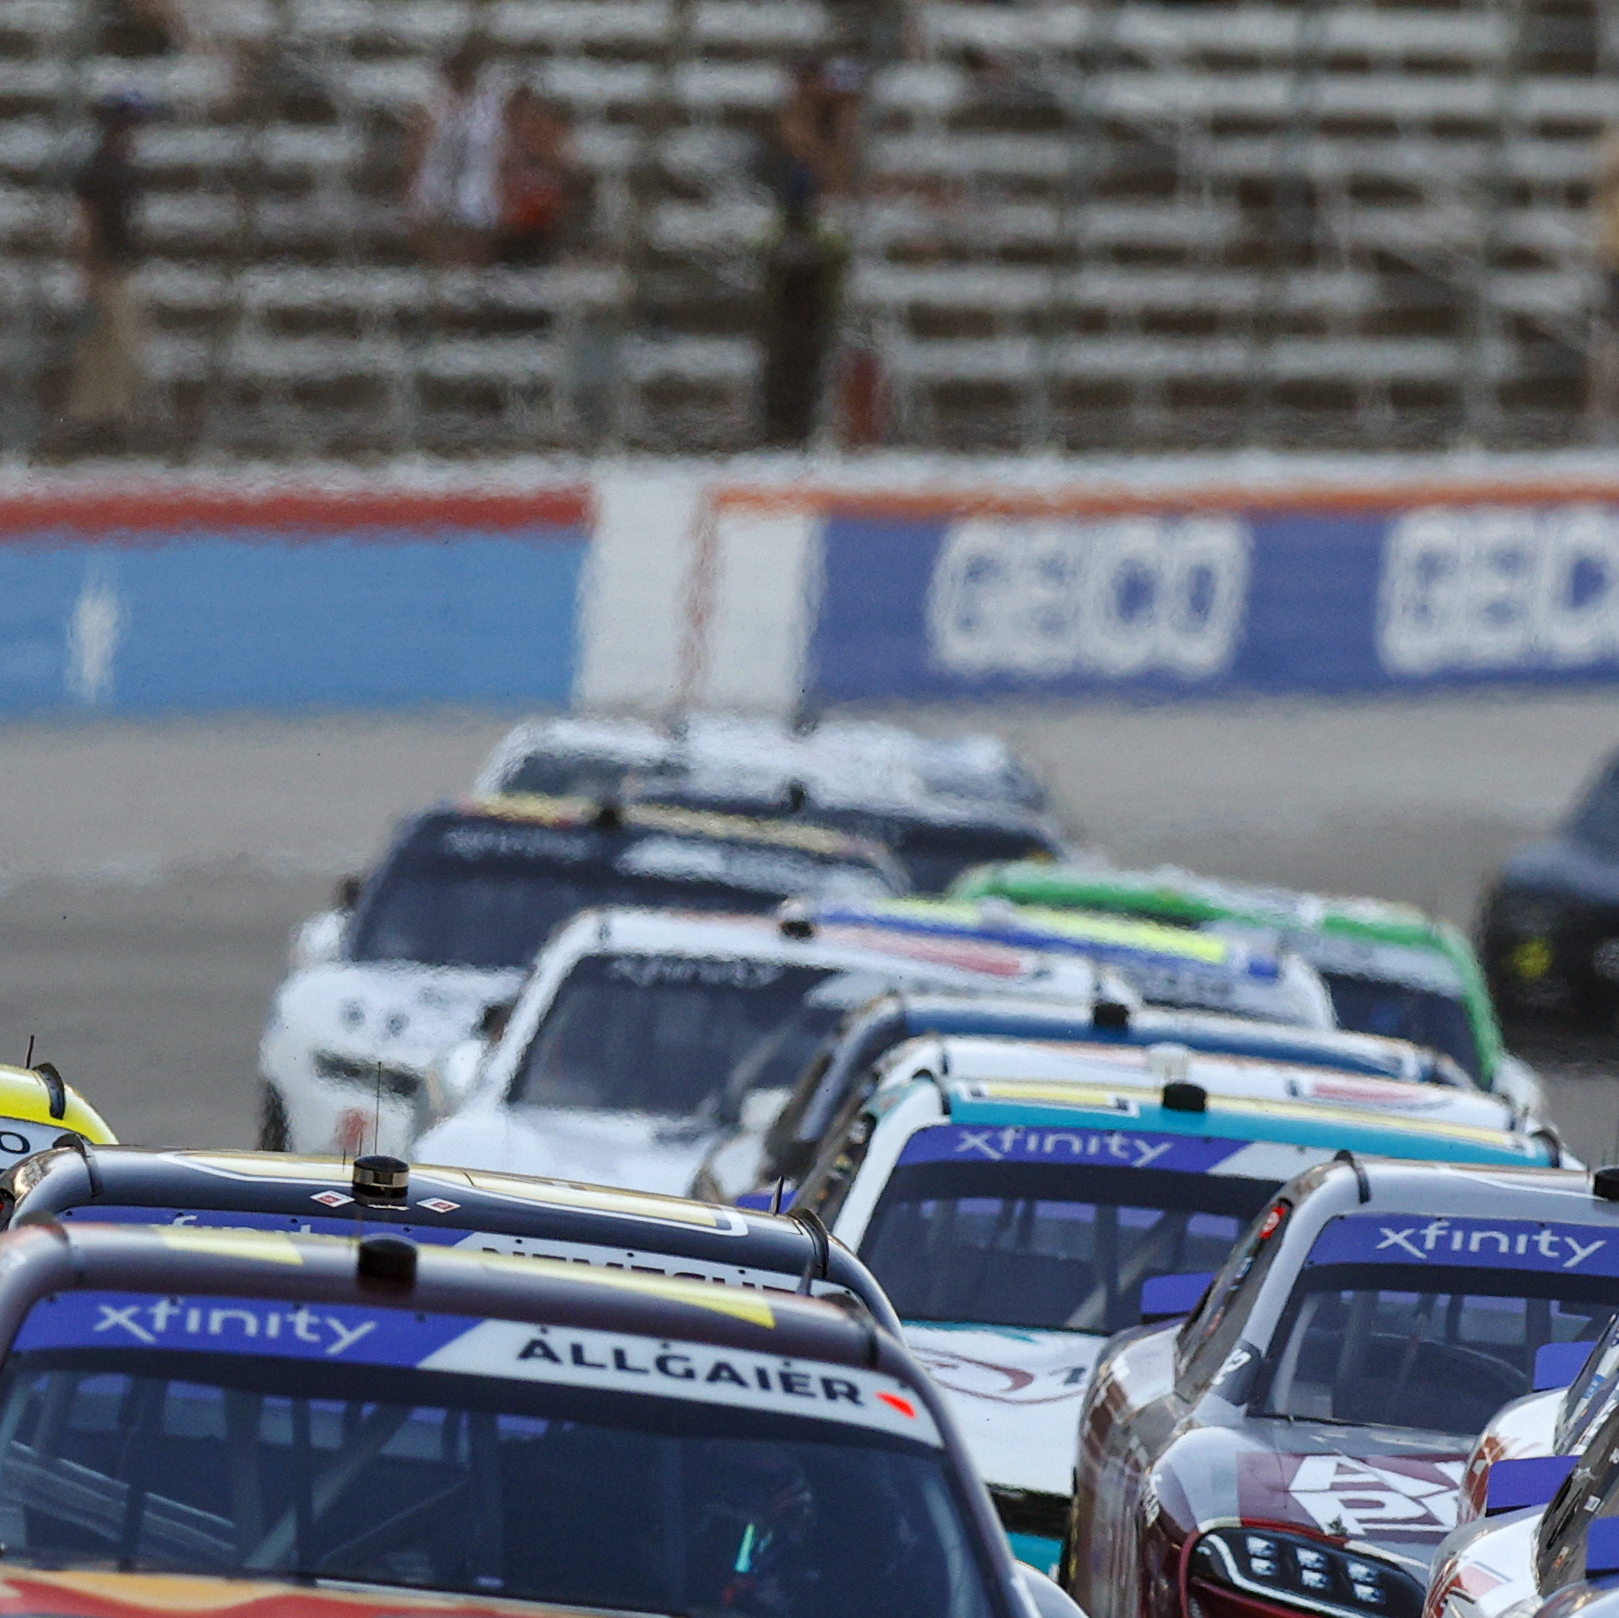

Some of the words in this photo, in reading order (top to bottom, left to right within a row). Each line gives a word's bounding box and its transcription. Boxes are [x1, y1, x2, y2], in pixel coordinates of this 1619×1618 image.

[926, 514, 1251, 678] GEICO
[954, 1126, 1174, 1167] xfinity
[1376, 1220, 1607, 1268] xfinity
[93, 1298, 376, 1355] xfinity
[517, 1339, 864, 1406] ALLGAIER
